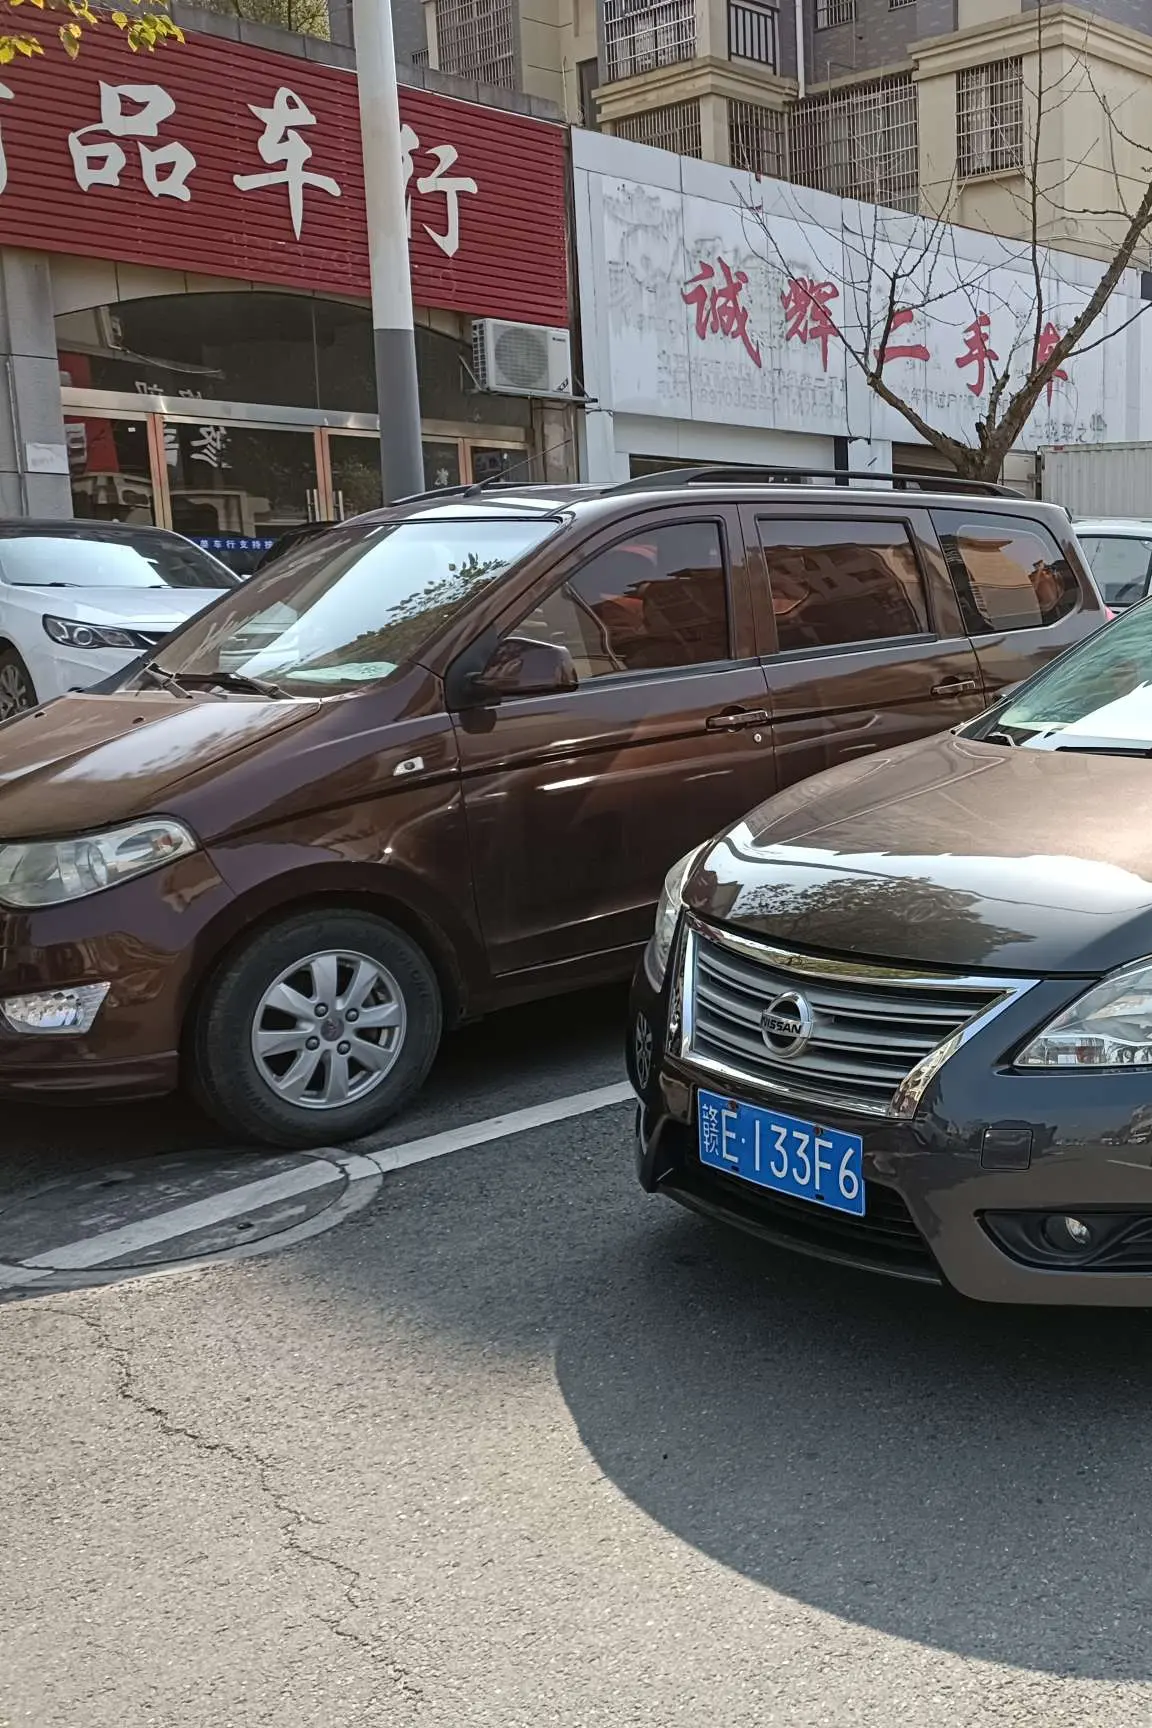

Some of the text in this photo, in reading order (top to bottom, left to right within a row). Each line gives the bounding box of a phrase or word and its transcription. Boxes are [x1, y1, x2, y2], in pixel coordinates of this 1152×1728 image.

[0, 79, 479, 258] 品车行
[761, 1015, 803, 1035] NISSAN
